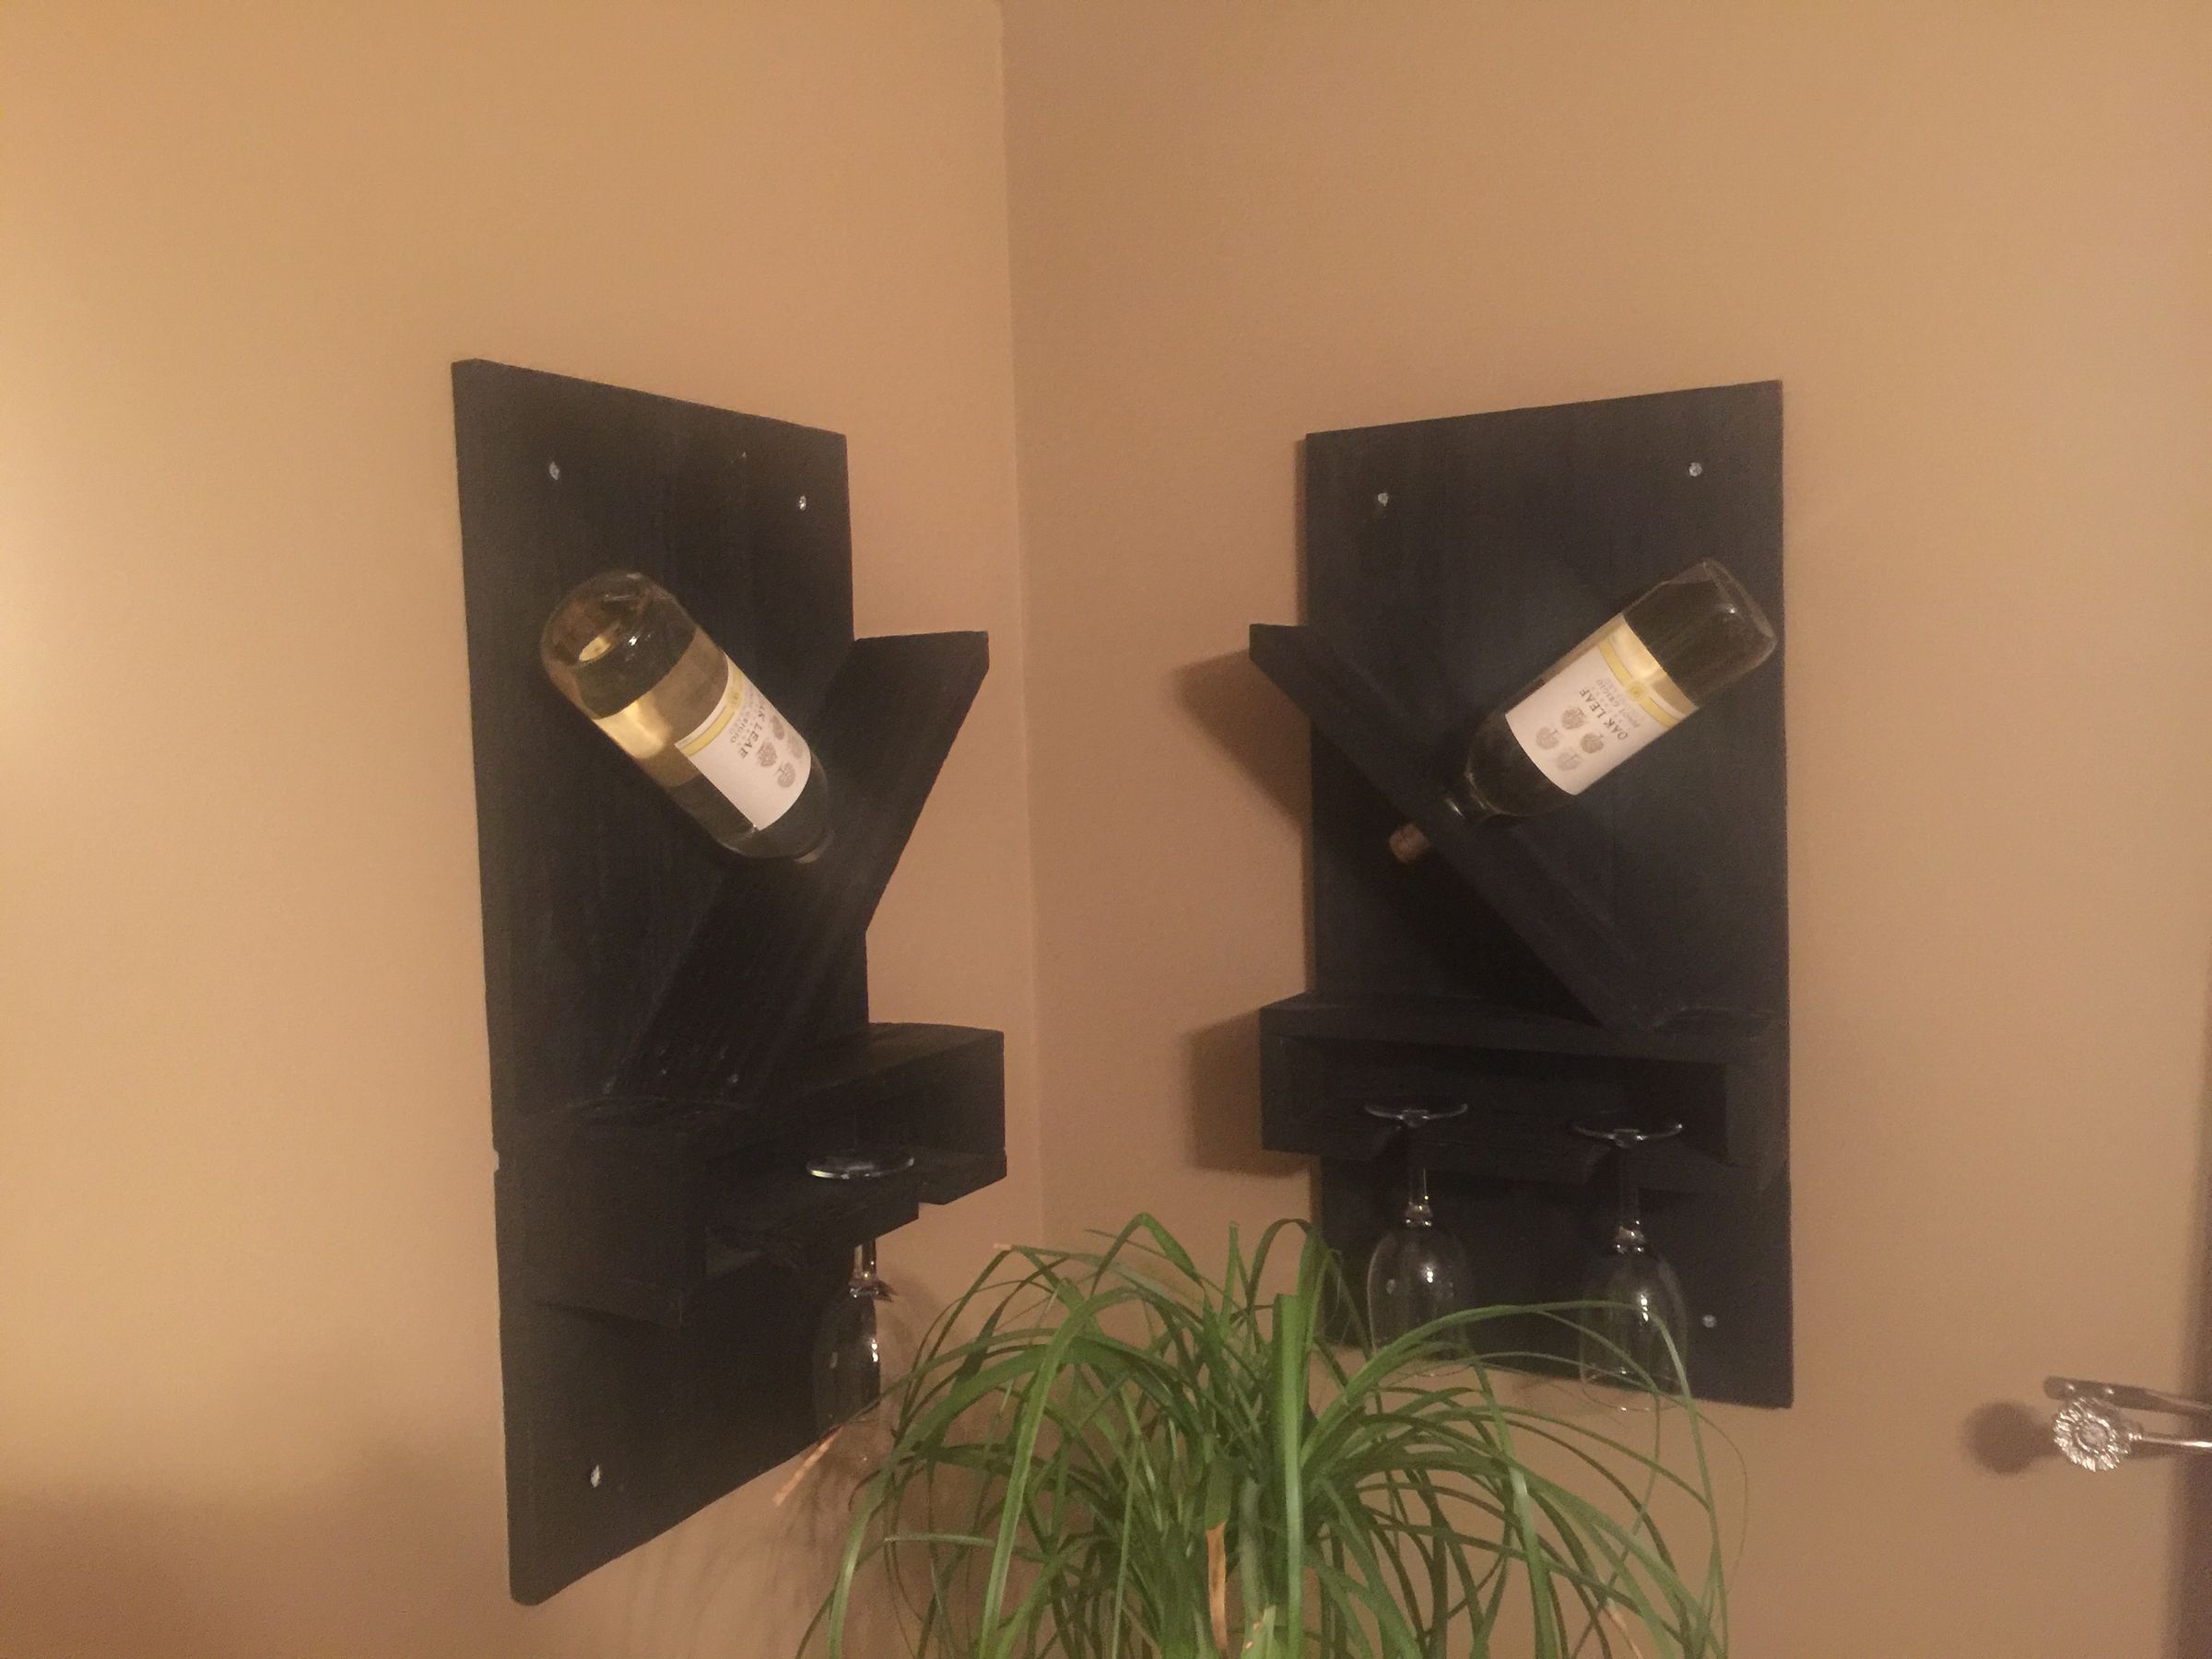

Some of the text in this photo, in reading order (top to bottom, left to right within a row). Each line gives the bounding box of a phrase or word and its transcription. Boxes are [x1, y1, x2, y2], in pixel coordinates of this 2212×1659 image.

[1579, 688, 1606, 718] LEAF
[738, 723, 762, 759] LEAF
[1604, 718, 1629, 740] OAK
